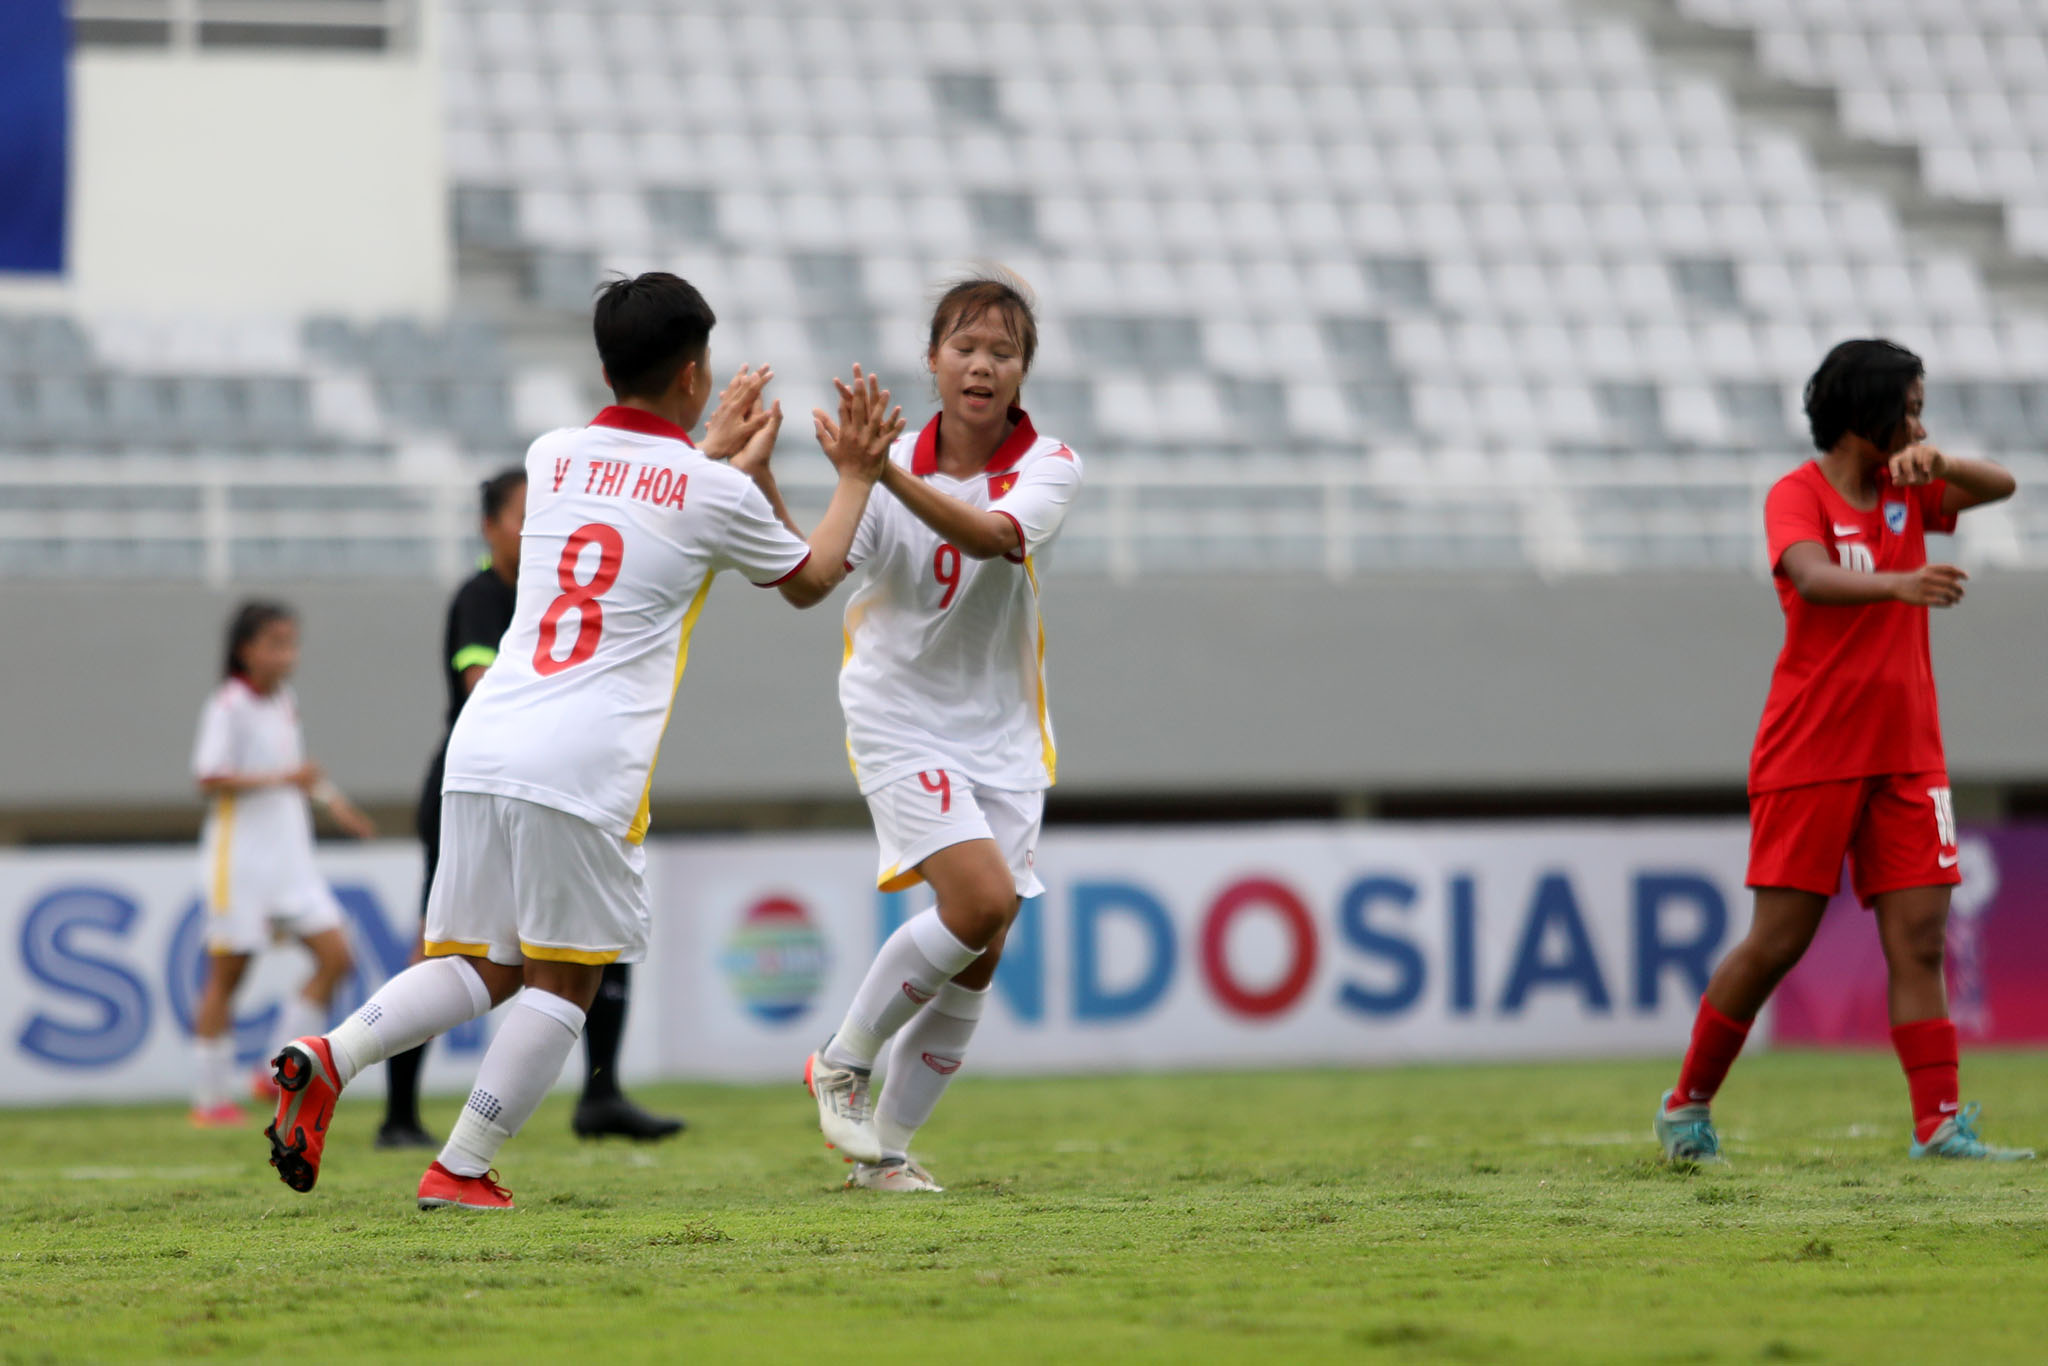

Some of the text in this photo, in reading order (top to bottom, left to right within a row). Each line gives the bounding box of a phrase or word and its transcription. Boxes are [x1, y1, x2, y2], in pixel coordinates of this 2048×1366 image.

[585, 461, 631, 496] THI
[632, 466, 688, 511] HOA
[532, 523, 624, 677] 8
[933, 543, 961, 610] 9
